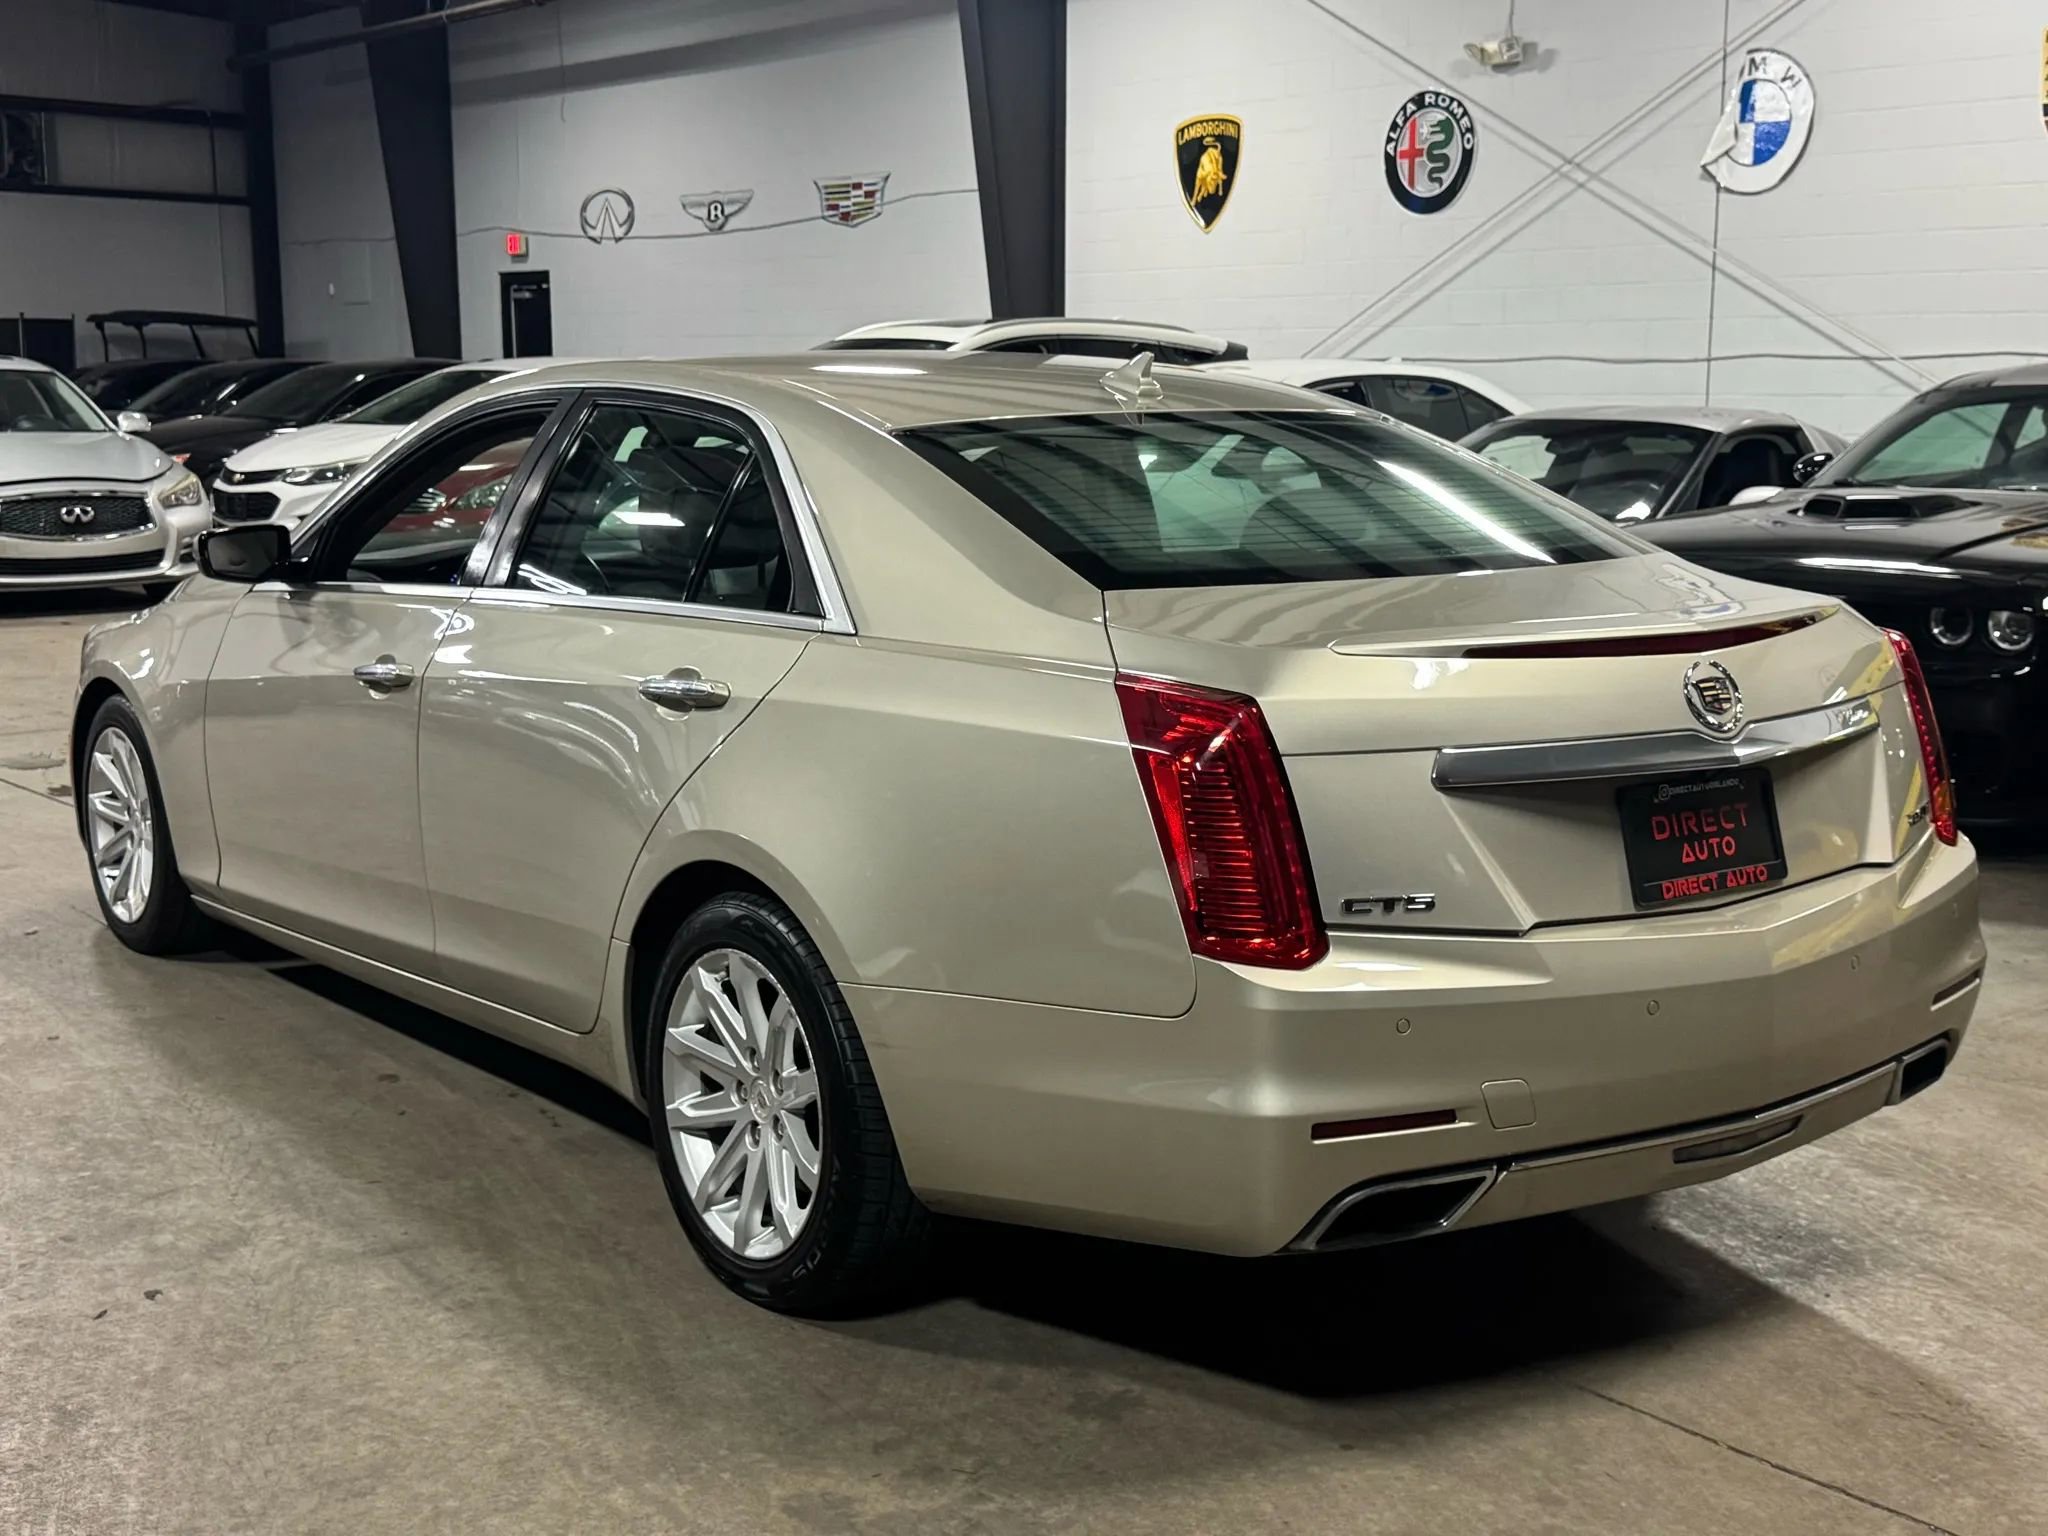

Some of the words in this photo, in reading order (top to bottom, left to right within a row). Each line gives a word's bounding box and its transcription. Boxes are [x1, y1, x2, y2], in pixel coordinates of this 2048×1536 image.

[1738, 56, 1802, 88] MW
[1178, 121, 1239, 145] LAMBORGHINI
[1386, 101, 1417, 157] ALFA
[1424, 92, 1474, 150] ROMEO
[1652, 803, 1748, 840] DIRECT
[1682, 835, 1736, 863] AUTO
[1662, 872, 1719, 900] DIRECT
[1726, 864, 1768, 888] AUTO
[1341, 892, 1436, 914] CTS
